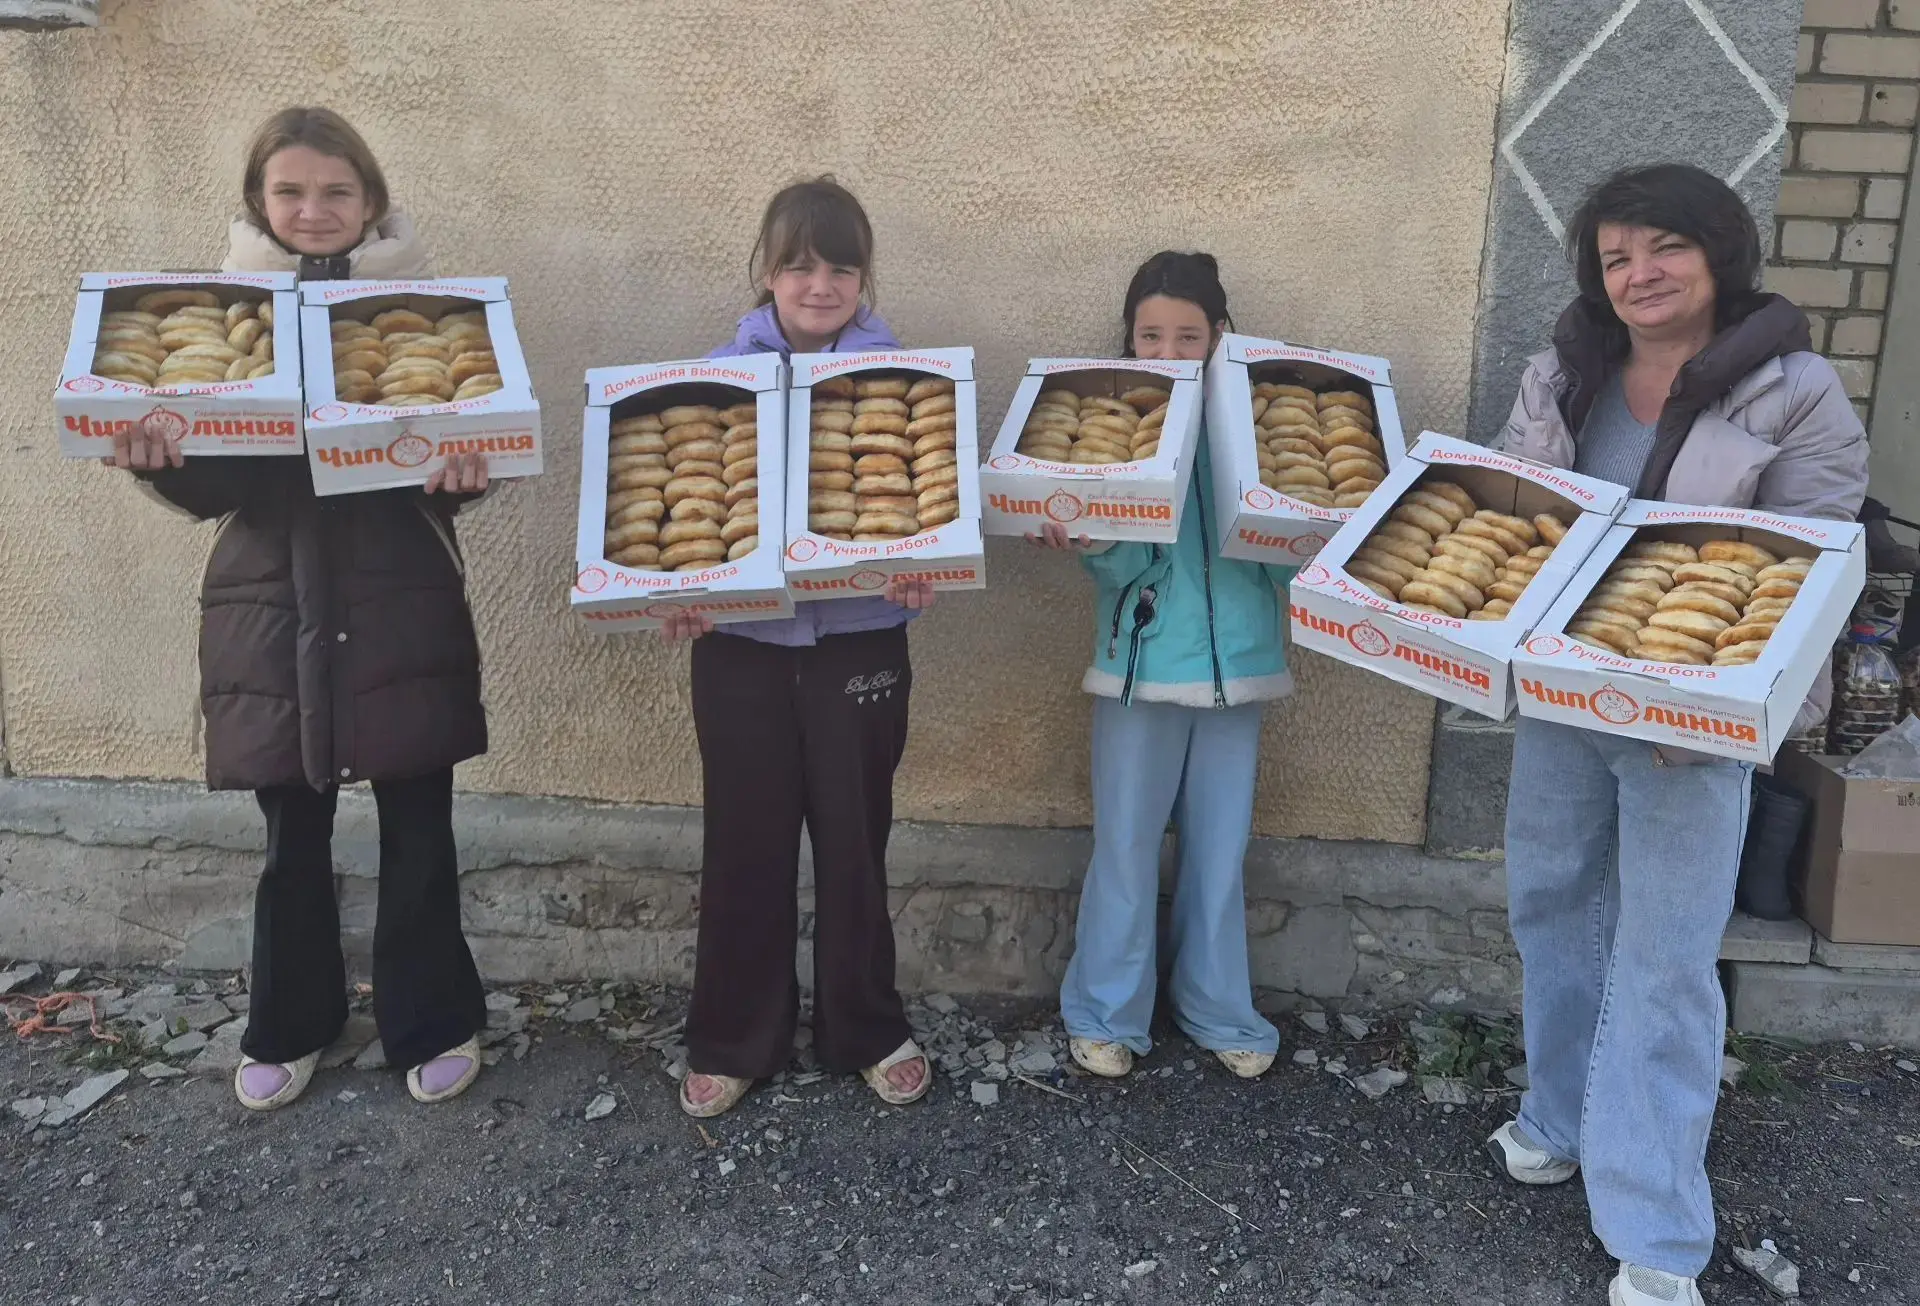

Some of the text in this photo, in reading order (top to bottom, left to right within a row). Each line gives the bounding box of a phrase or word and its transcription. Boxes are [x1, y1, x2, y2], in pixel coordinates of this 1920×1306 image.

[810, 354, 952, 377] Домашняя выпечка
[1245, 347, 1376, 376] Домашняя выпечка
[604, 366, 756, 398] Домашняя выпечка
[192, 420, 295, 436] линия
[316, 435, 534, 468] Чип линия
[1025, 459, 1076, 474] Ручная
[1429, 449, 1596, 502] Домашняя выпечка
[988, 493, 1171, 520] Чип линия
[1279, 496, 1331, 518] Ручная
[1239, 528, 1289, 547] Чип
[1645, 510, 1828, 540] Домашняя выпечка
[824, 533, 939, 557] Ручная работа
[614, 565, 738, 587] Ручная работа
[1333, 578, 1463, 630] Ручная работа
[1290, 605, 1490, 690] Чип линия
[1568, 644, 1717, 680] Ручная работа
[1520, 677, 1757, 743] Чип линия
[1675, 731, 1700, 741] Более
